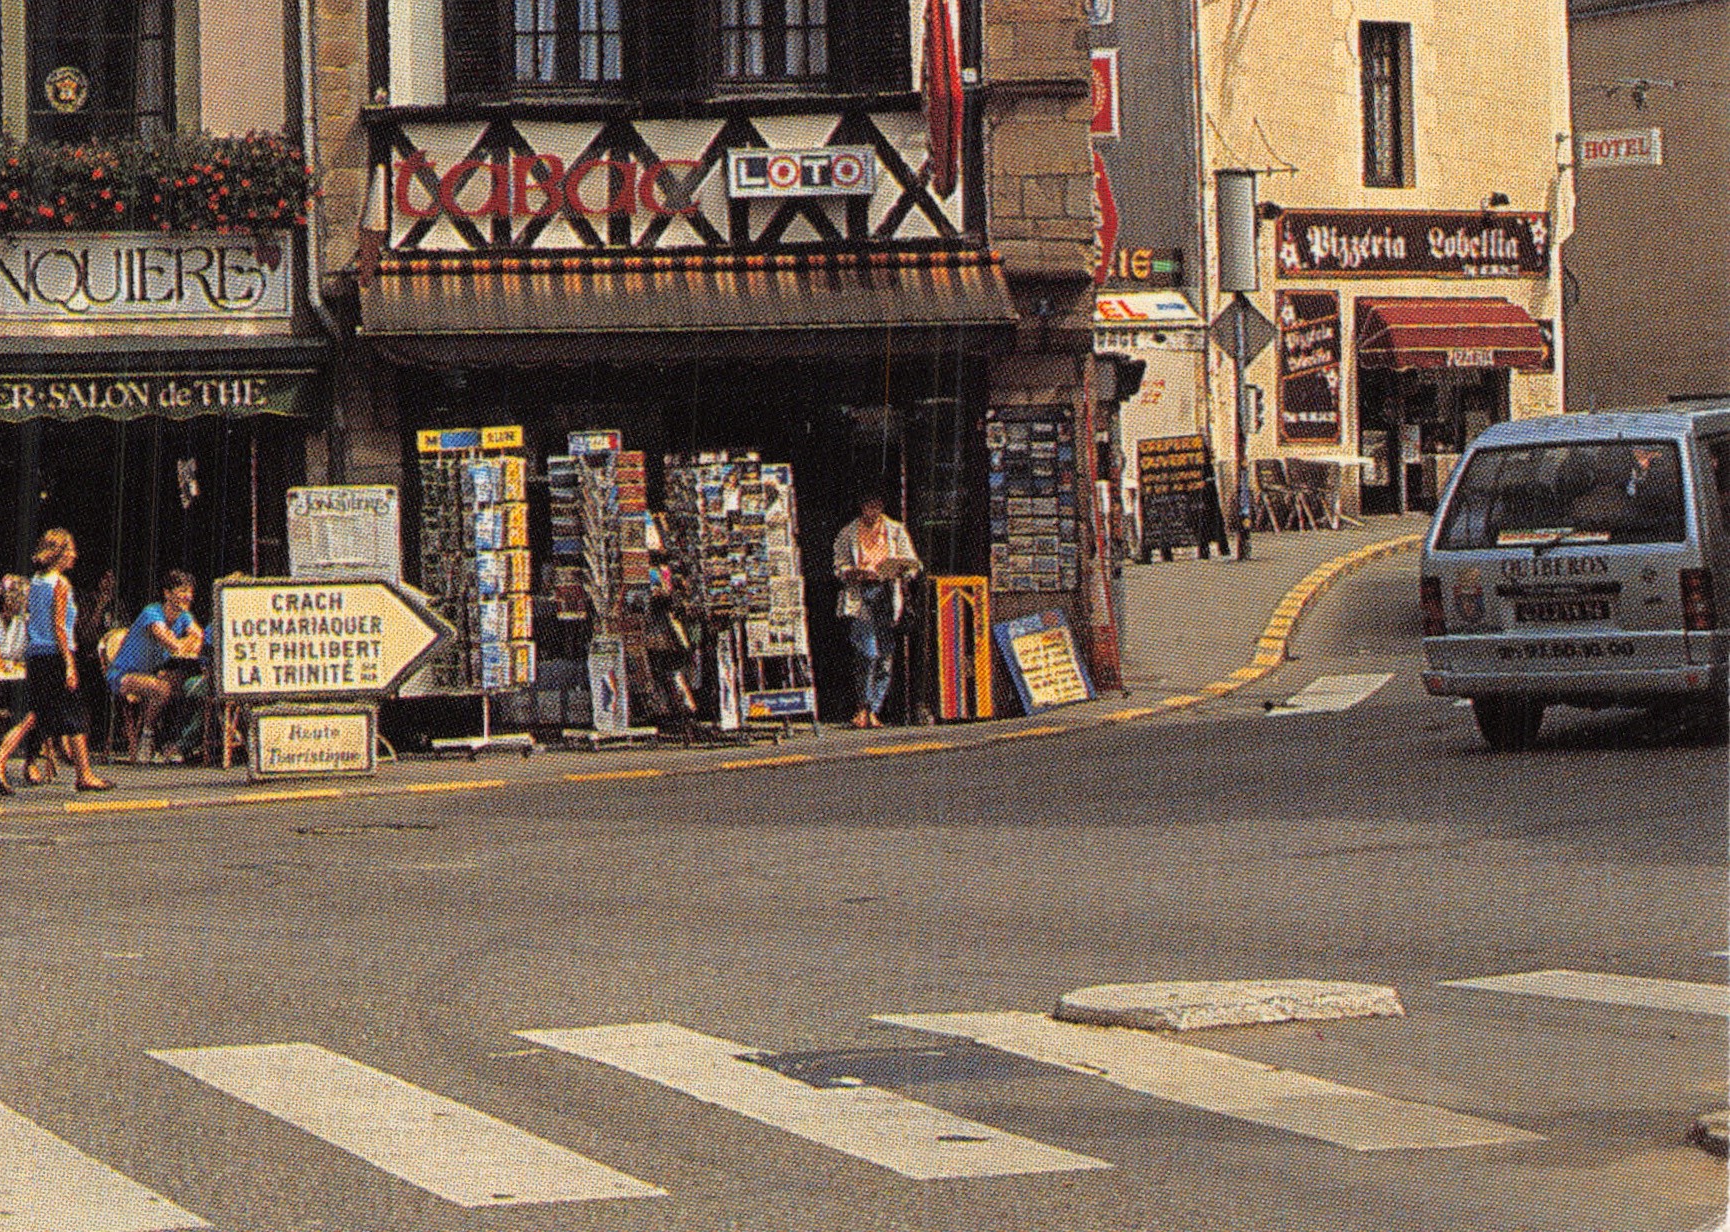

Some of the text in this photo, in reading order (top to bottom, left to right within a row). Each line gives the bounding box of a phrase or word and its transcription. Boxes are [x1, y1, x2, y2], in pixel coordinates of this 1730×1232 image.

[1582, 136, 1649, 160] HOTEL
[737, 153, 865, 189] LOTO
[46, 381, 150, 409] SALON
[159, 383, 192, 408] de
[198, 379, 269, 407] THE
[1500, 555, 1610, 579] QUIBERON
[270, 591, 344, 613] CRACH
[231, 615, 383, 638] LOCMARIAQUER
[268, 639, 382, 661] PHILIBERT
[236, 665, 262, 687] LA
[272, 659, 355, 686] TRINITÉ
[287, 723, 342, 742] Route
[268, 747, 362, 768] Touristique
